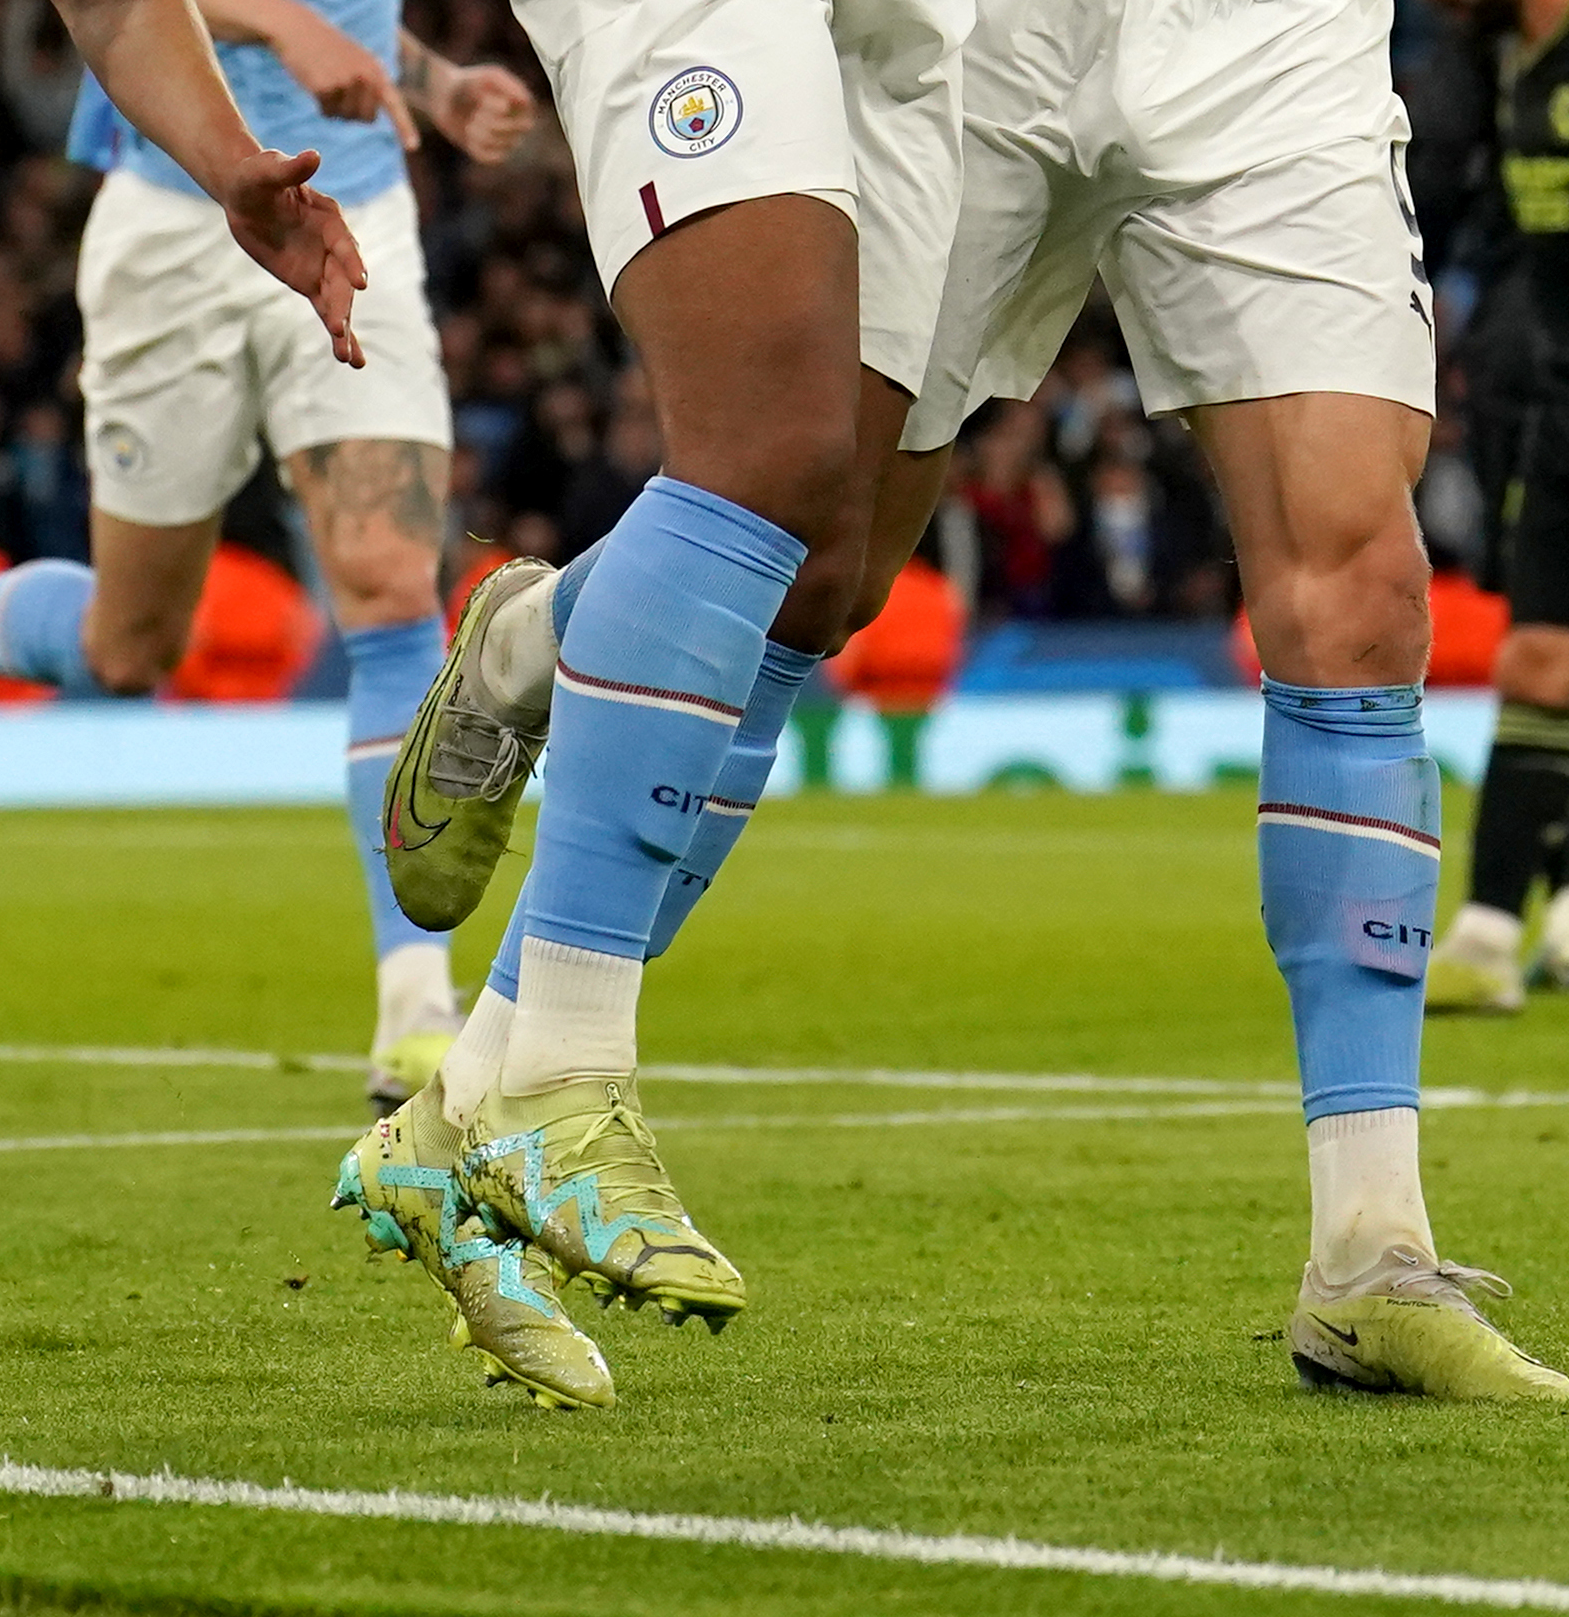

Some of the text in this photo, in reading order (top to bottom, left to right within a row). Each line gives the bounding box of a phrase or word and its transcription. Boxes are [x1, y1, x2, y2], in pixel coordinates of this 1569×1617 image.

[657, 73, 728, 116] MANCHESTER
[689, 137, 716, 153] CITY
[651, 785, 709, 816] CIT
[1362, 920, 1433, 949] CIT
